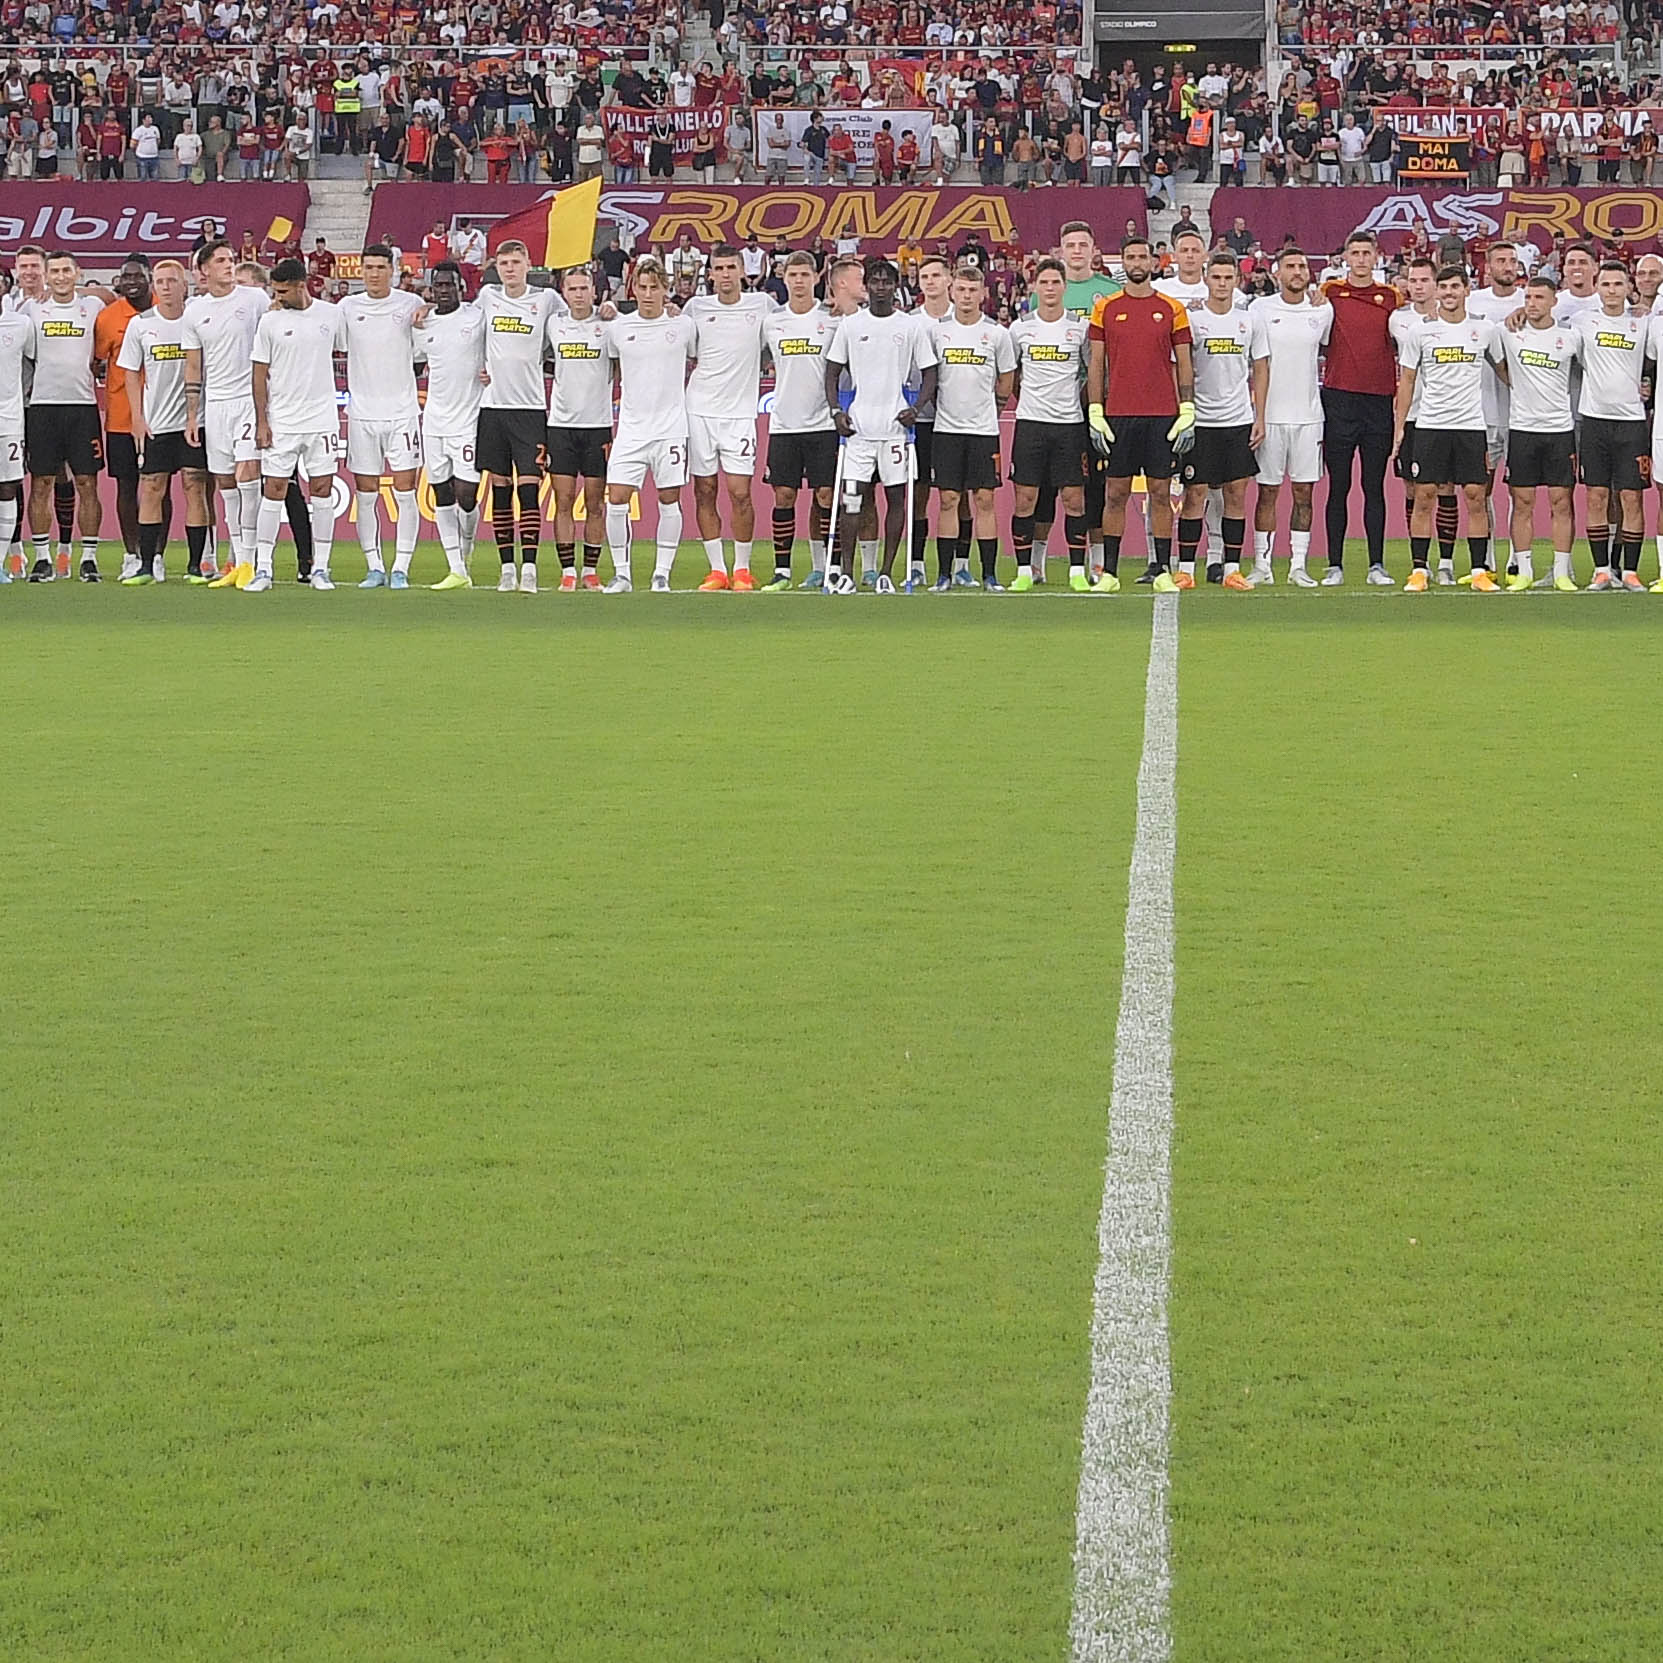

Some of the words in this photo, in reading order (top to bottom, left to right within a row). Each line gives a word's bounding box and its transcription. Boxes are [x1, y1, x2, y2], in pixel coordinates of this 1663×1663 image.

[1419, 143, 1449, 155] MAI
[1408, 157, 1459, 171] DOMA
[648, 191, 1016, 243] ROMA
[1357, 192, 1504, 240] AS
[323, 434, 338, 453] 19
[404, 431, 419, 451] 14
[463, 445, 473, 462] 6
